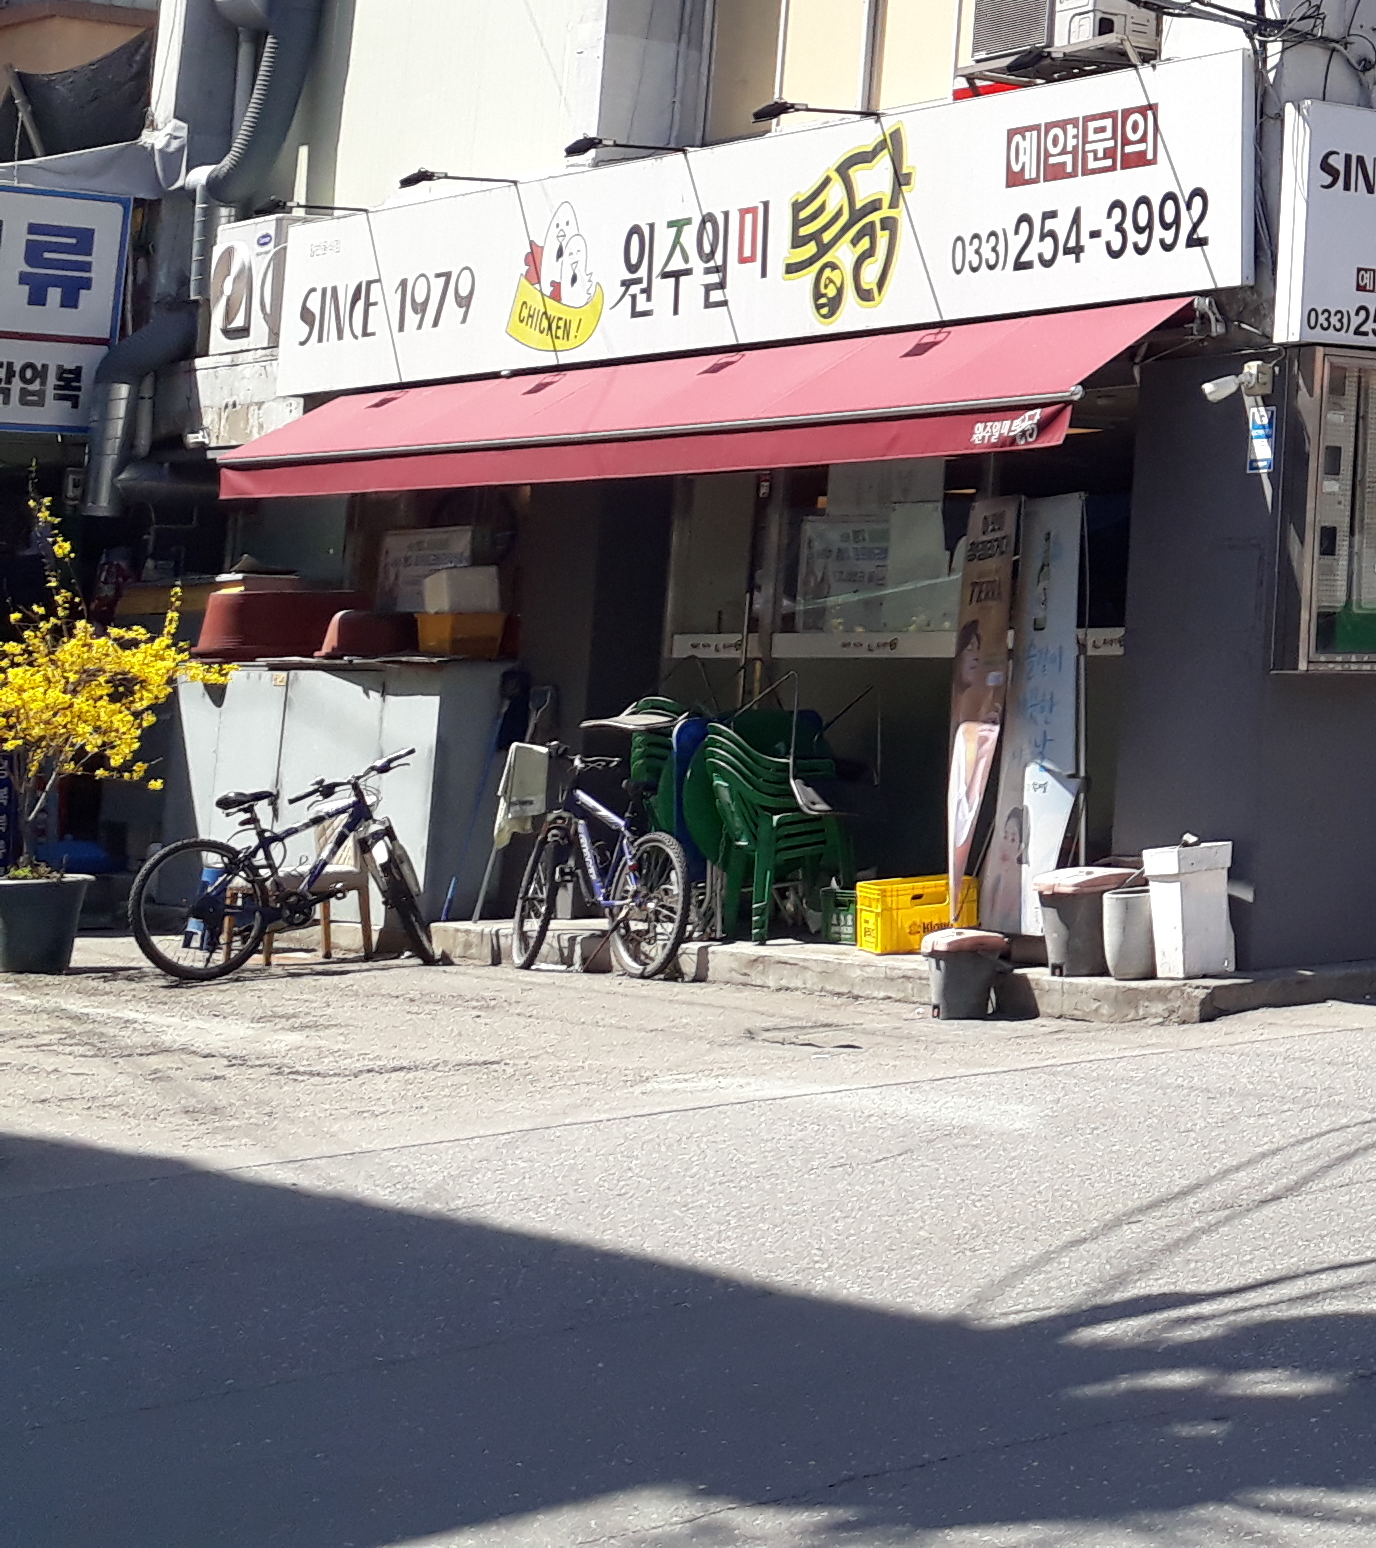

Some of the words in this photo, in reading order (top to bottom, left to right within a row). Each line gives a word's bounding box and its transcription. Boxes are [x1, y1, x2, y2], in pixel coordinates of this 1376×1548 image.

[1007, 104, 1157, 187] 예약문의
[609, 200, 770, 319] 원주일미
[952, 187, 1209, 275] 033)254-3992
[299, 278, 380, 346] SINCE
[396, 265, 476, 333] 1979
